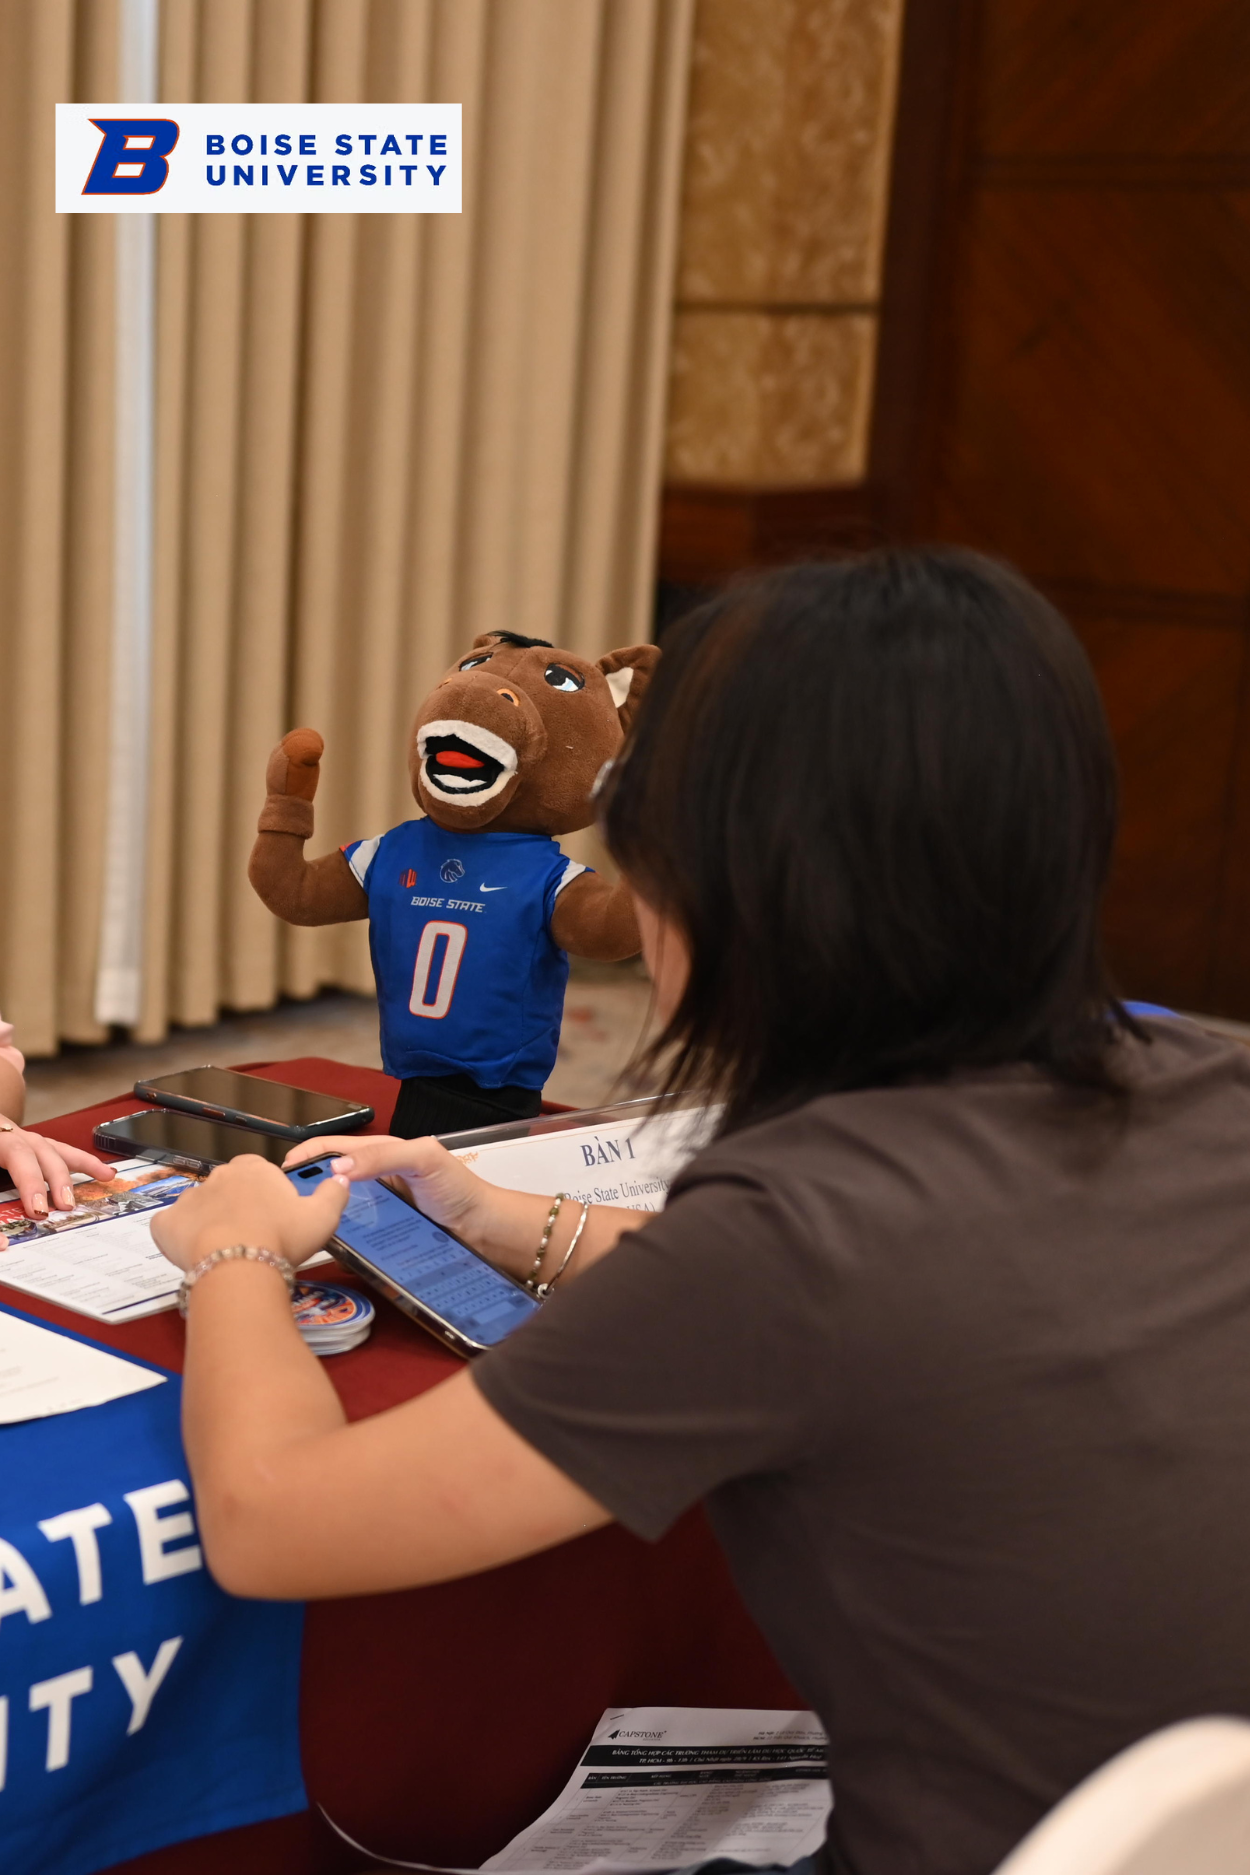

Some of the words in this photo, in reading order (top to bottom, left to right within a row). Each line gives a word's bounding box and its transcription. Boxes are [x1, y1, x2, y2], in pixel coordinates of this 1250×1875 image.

[411, 896, 445, 909] BOISE
[446, 899, 485, 913] STATE
[408, 919, 468, 1020] 0
[580, 1136, 622, 1167] BÀN
[594, 1187, 619, 1203] State
[620, 1176, 670, 1198] University
[618, 1730, 664, 1739] CAPSTONE
